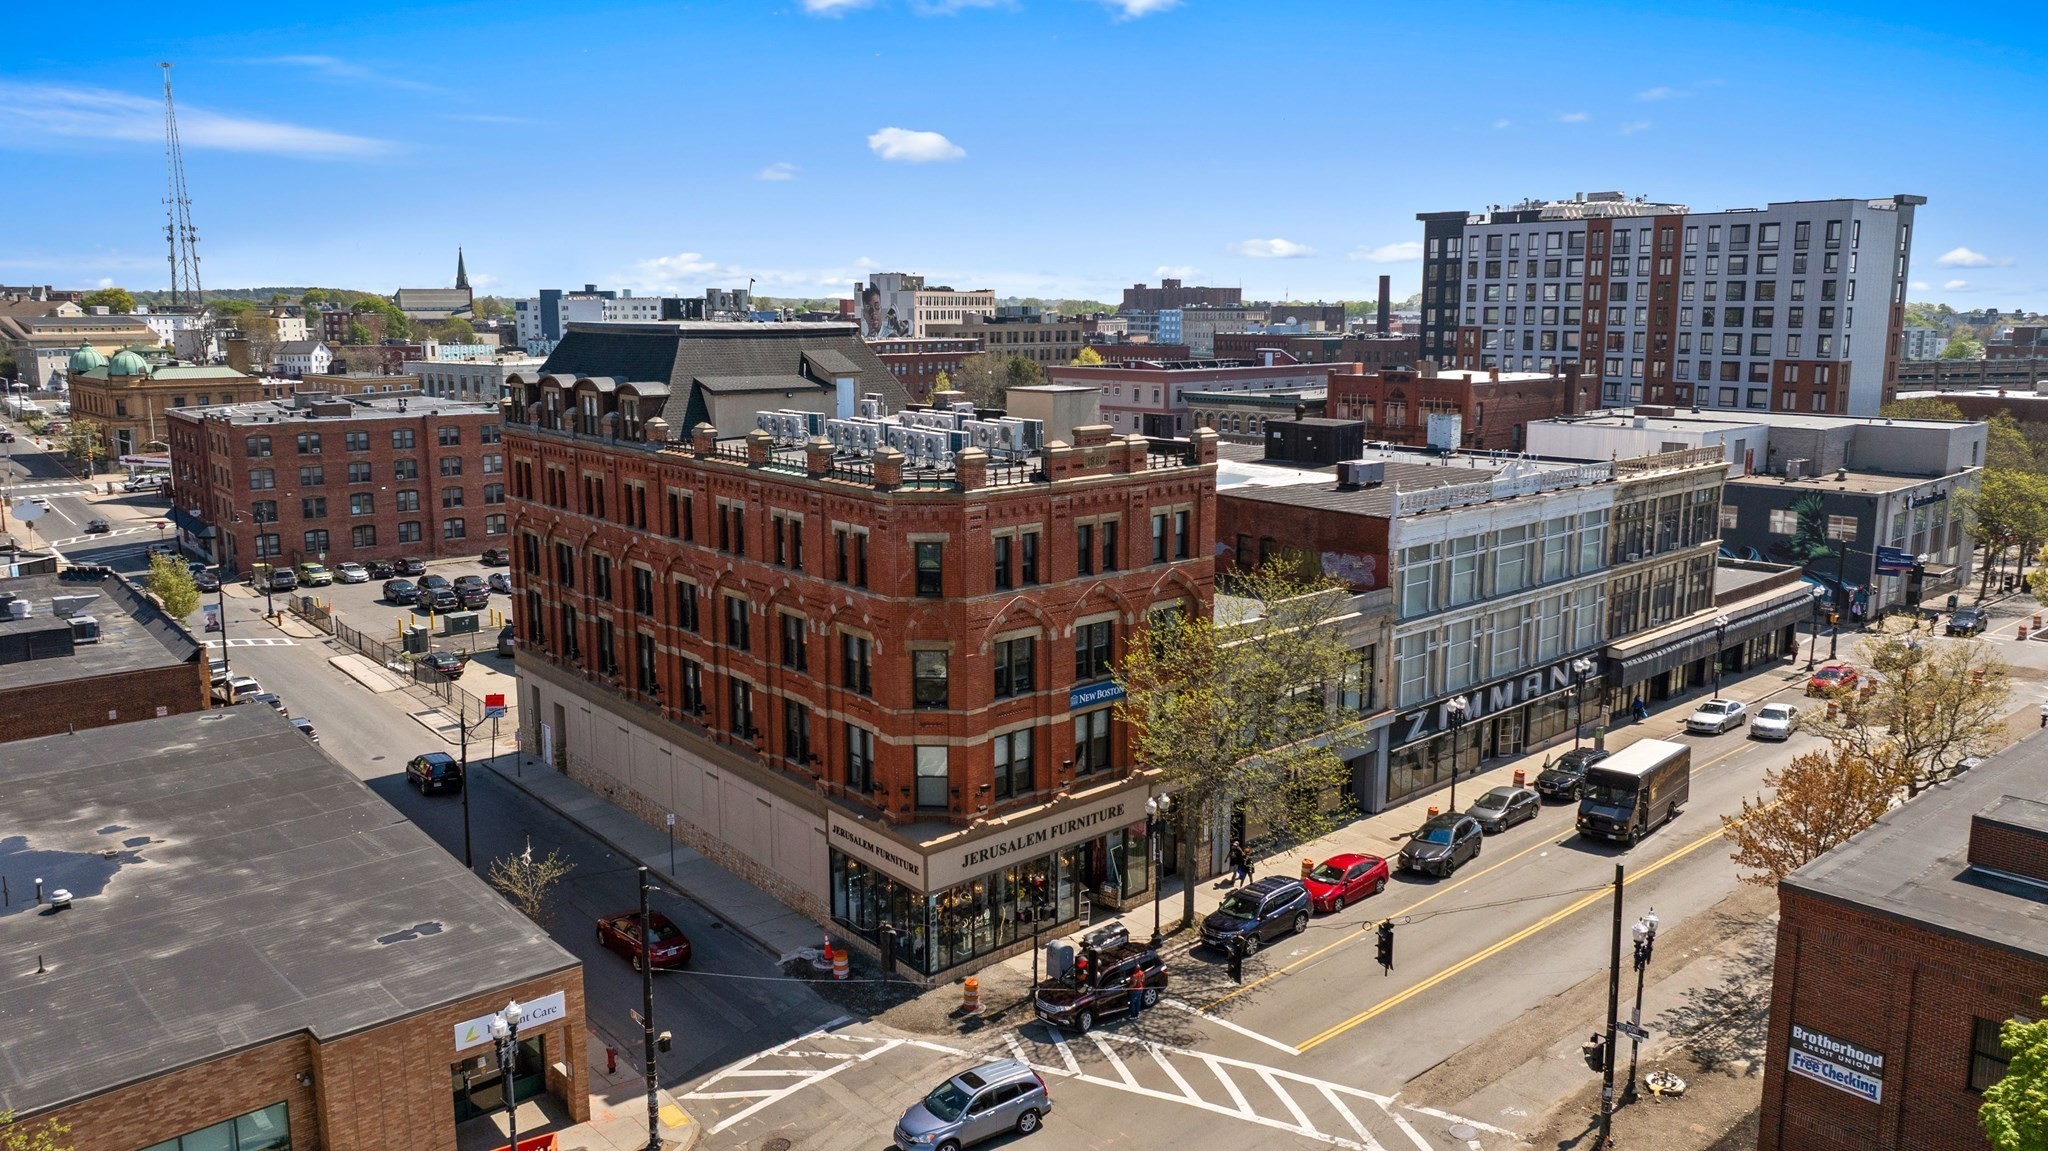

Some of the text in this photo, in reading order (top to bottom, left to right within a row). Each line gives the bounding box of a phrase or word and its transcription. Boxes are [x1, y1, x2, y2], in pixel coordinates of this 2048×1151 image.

[1087, 455, 1105, 466] 1880
[1079, 692, 1096, 704] NEW
[832, 825, 919, 876] JERUSALEM FURNITURE
[962, 803, 1125, 868] JERUSALEM FURNITURE
[533, 1005, 557, 1019] Care
[1793, 1025, 1883, 1068] Brotherhood
[1802, 1042, 1834, 1058] CREDIT
[1838, 1055, 1870, 1071] UNION
[1793, 1052, 1878, 1100] Free Checking
